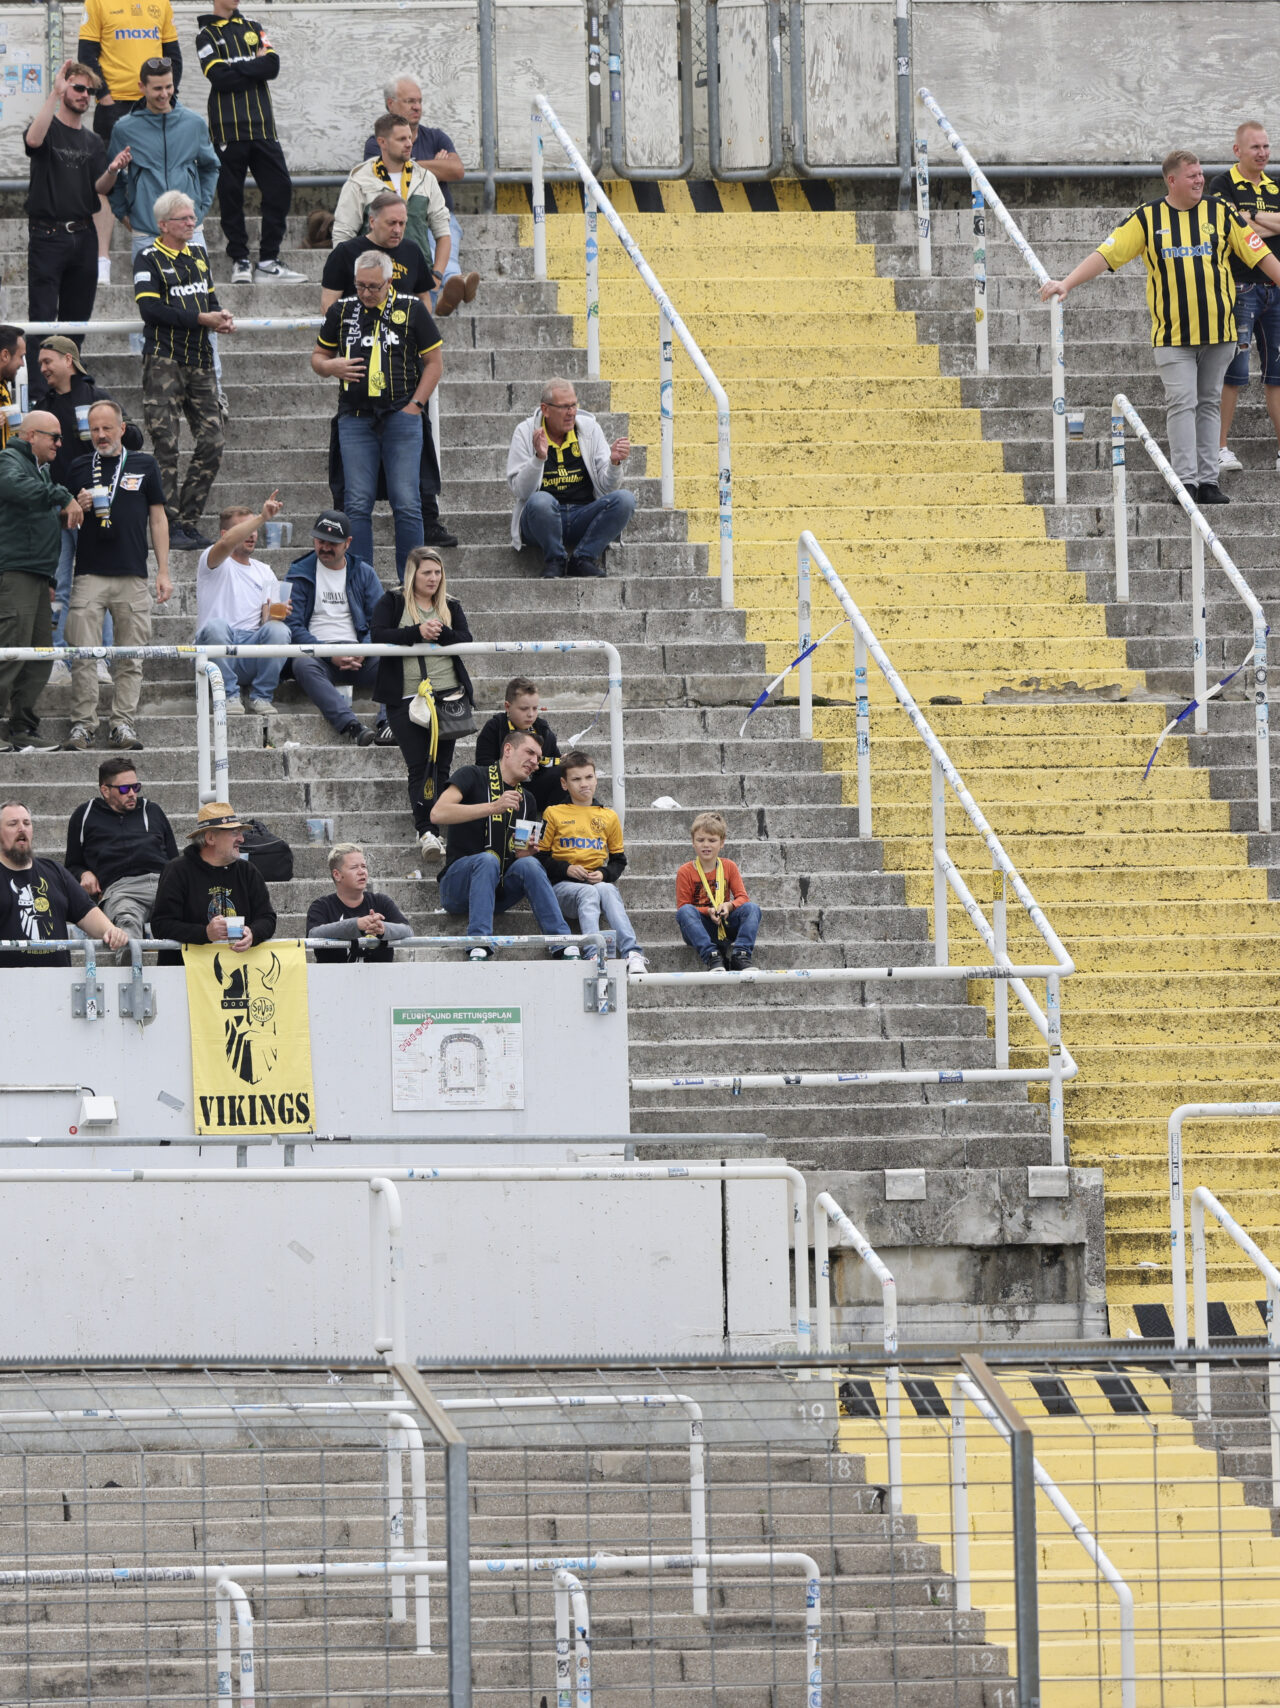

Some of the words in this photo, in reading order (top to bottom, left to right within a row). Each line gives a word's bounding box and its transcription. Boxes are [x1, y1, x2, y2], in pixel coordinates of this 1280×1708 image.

[115, 27, 160, 41] maxit
[1162, 242, 1212, 259] maxit
[560, 837, 604, 850] maxit
[453, 1012, 512, 1020] RETTUNGSPLAN
[199, 1092, 311, 1127] VIKINGS
[798, 1403, 825, 1425] 19
[825, 1457, 851, 1479] 18
[853, 1490, 879, 1513] 17
[880, 1518, 906, 1539] 16
[900, 1549, 926, 1571] 15
[922, 1583, 950, 1603] 14
[944, 1617, 970, 1639] 13
[970, 1652, 995, 1673] 12
[993, 1687, 1016, 1708] 11
